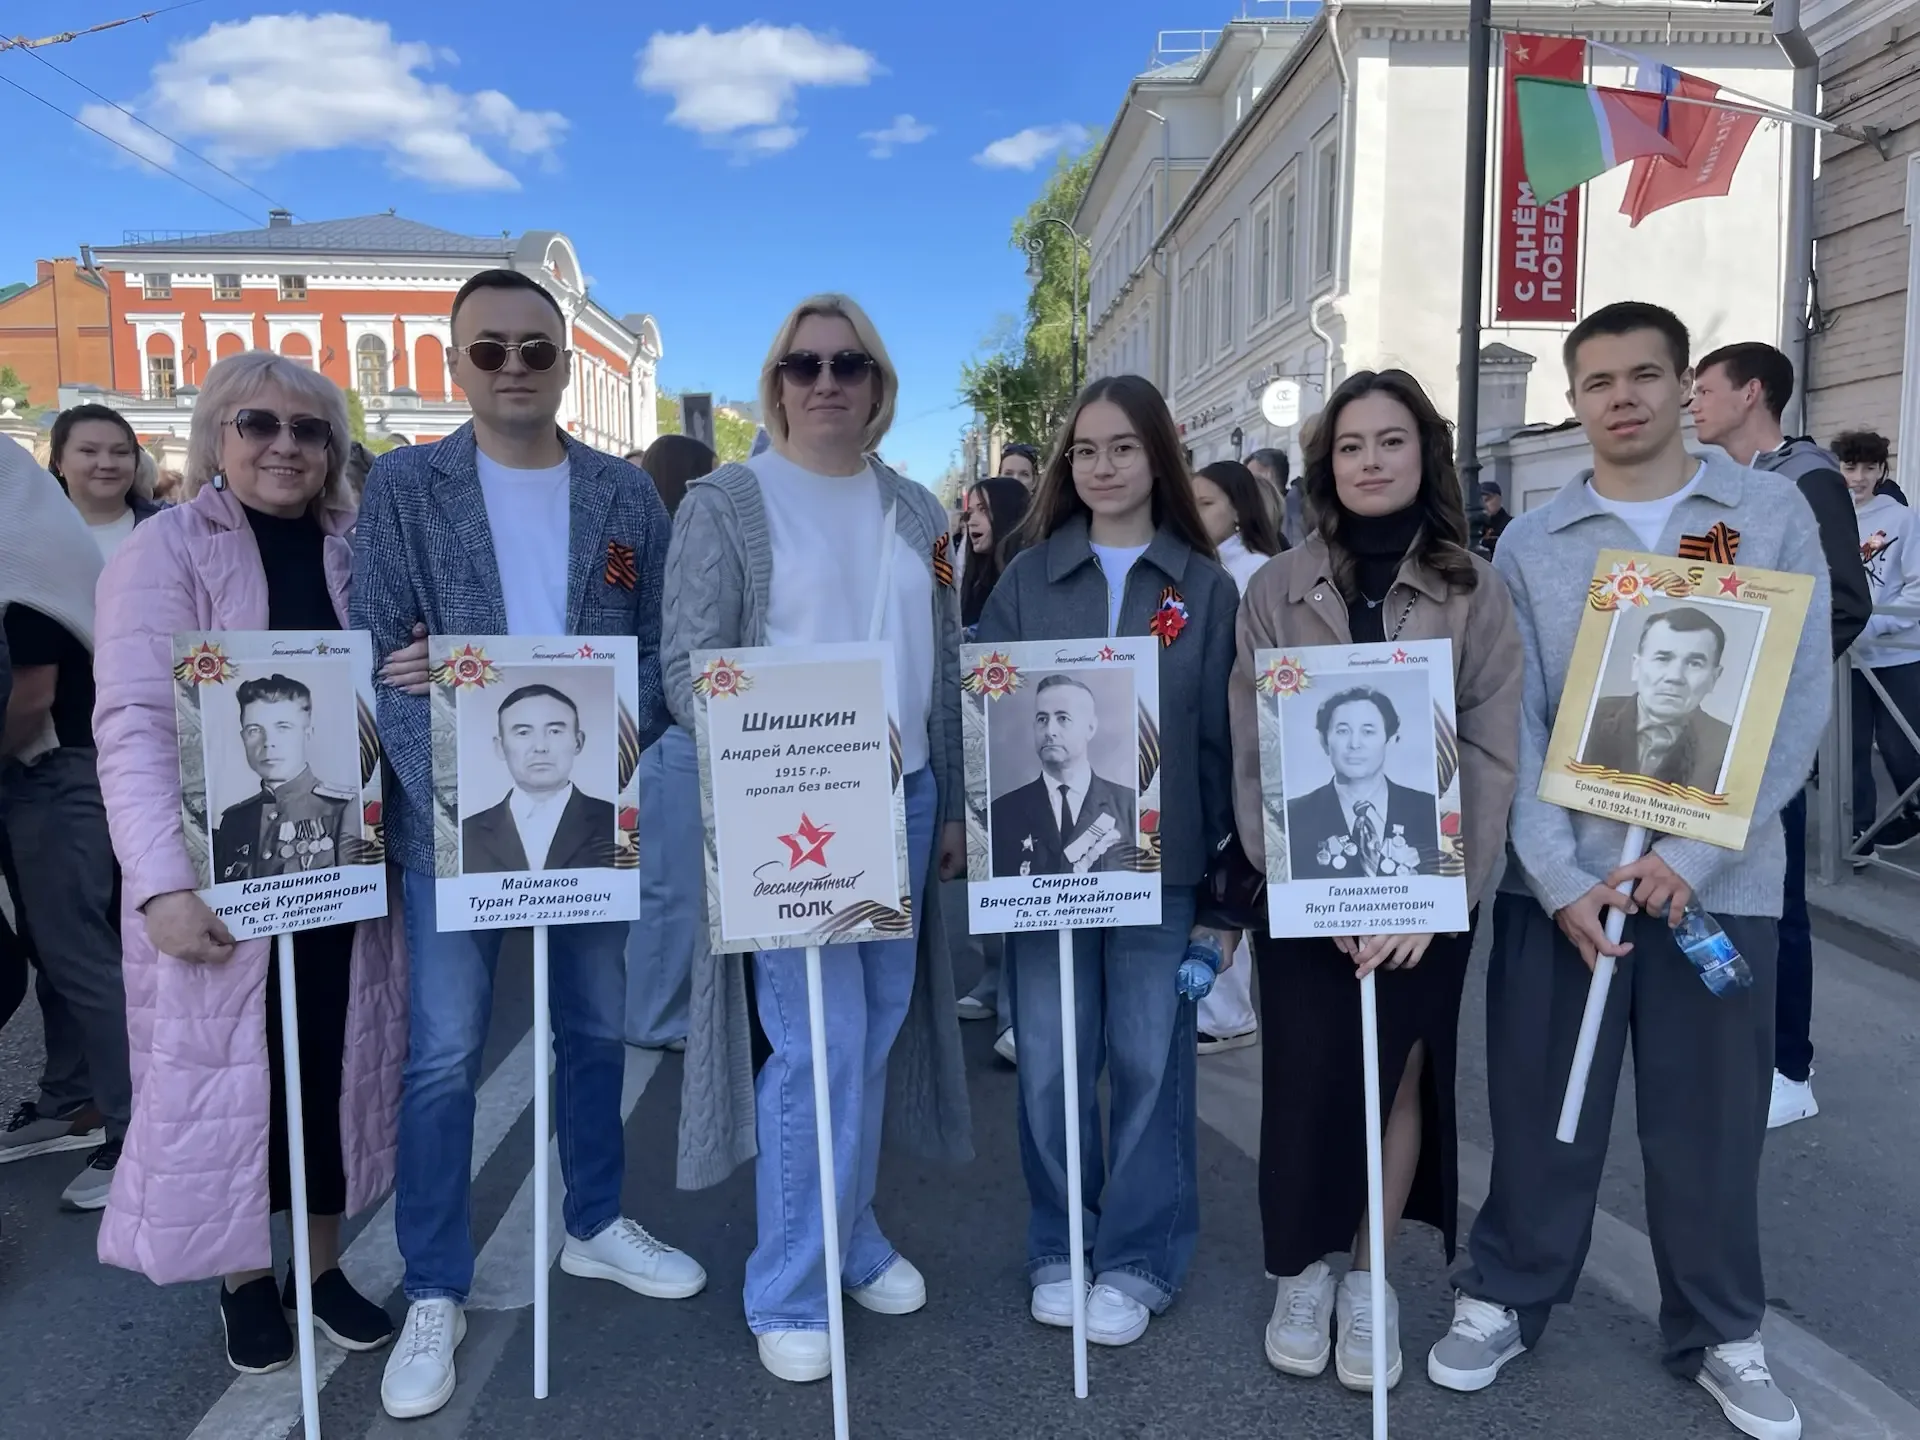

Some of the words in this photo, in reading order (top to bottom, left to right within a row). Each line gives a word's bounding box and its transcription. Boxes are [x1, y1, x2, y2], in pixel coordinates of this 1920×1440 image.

[1512, 182, 1540, 273] ДНЁМ
[1542, 193, 1569, 301] ПОБЕД
[1514, 280, 1535, 301] С
[329, 647, 351, 656] ПОЛК
[593, 651, 615, 660] ПОЛК
[1113, 653, 1136, 661] ПОЛК
[741, 710, 857, 732] Шишкин
[720, 745, 781, 762] Андрей
[785, 740, 881, 756] Алексеевич
[775, 766, 806, 778] 1915
[809, 766, 831, 777] г.р.
[746, 785, 794, 797] пропал
[798, 782, 820, 793] без
[824, 780, 861, 791] вести
[1574, 779, 1621, 799] Ермолаев
[1622, 791, 1648, 805] Иван
[1648, 796, 1711, 821] Михайлович
[1588, 798, 1676, 827] 4.10.1924-1.11.1978
[242, 871, 341, 895] Калашников
[501, 877, 579, 891] Маймаков
[1032, 875, 1099, 891] Смирнов
[1328, 885, 1409, 897] Галиахметов
[215, 897, 271, 918] лексей
[276, 883, 378, 909] Куприянович
[469, 895, 514, 911] Туран
[518, 892, 611, 906] Рахманович
[980, 895, 1051, 908] Вячеслав
[1056, 890, 1152, 904] Михайлович
[1305, 902, 1335, 916] Якуп
[1339, 899, 1435, 913] Галиахметович
[242, 915, 259, 926] Гв.
[263, 911, 279, 923] ст.
[282, 901, 344, 920] лейтенант
[473, 912, 527, 923] 15.07.1924
[537, 909, 589, 919] 22.11.1998
[778, 900, 835, 919] ПОЛК
[1016, 909, 1032, 918] Гв.
[1036, 909, 1051, 917] ст.
[1054, 905, 1115, 917] лейтенант
[252, 924, 273, 935] 1909
[281, 916, 321, 930] 7.07.1958
[1013, 919, 1058, 929] 21.02.1921
[1065, 917, 1105, 926] 3.03.1972
[1313, 919, 1362, 929] 02.08.1927
[1369, 917, 1417, 927] 17.05.1995
